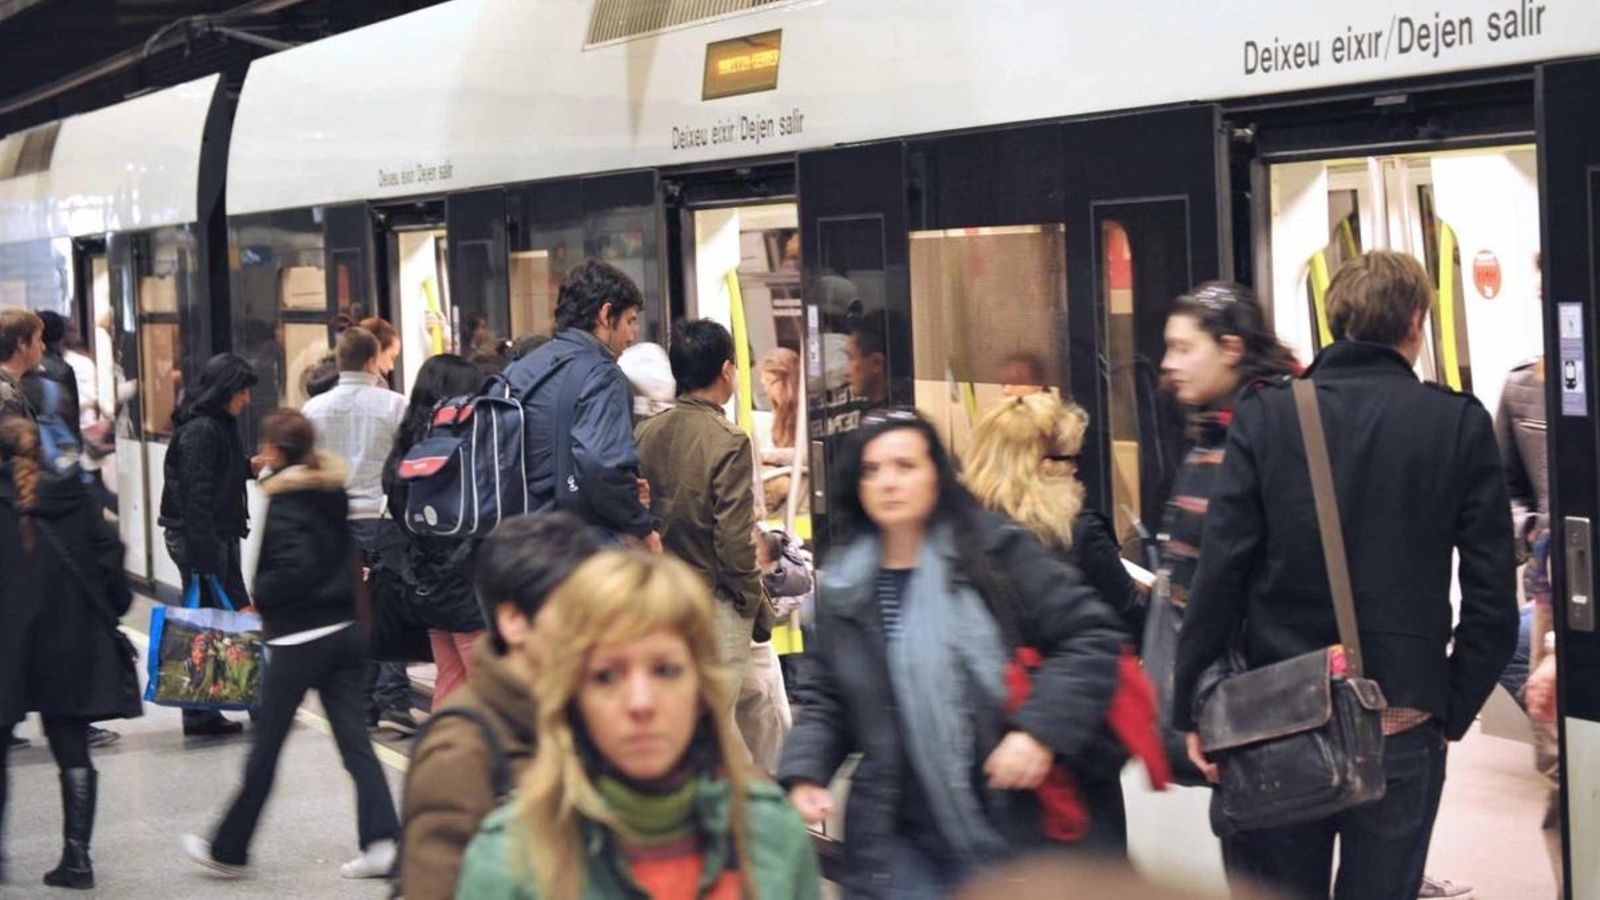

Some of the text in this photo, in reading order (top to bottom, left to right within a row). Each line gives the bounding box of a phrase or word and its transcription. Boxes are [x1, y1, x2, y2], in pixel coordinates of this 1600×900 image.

[1244, 37, 1320, 75] Deixeu
[1487, 0, 1546, 42] salir
[672, 125, 707, 150] Deixeu
[780, 107, 804, 136] salir
